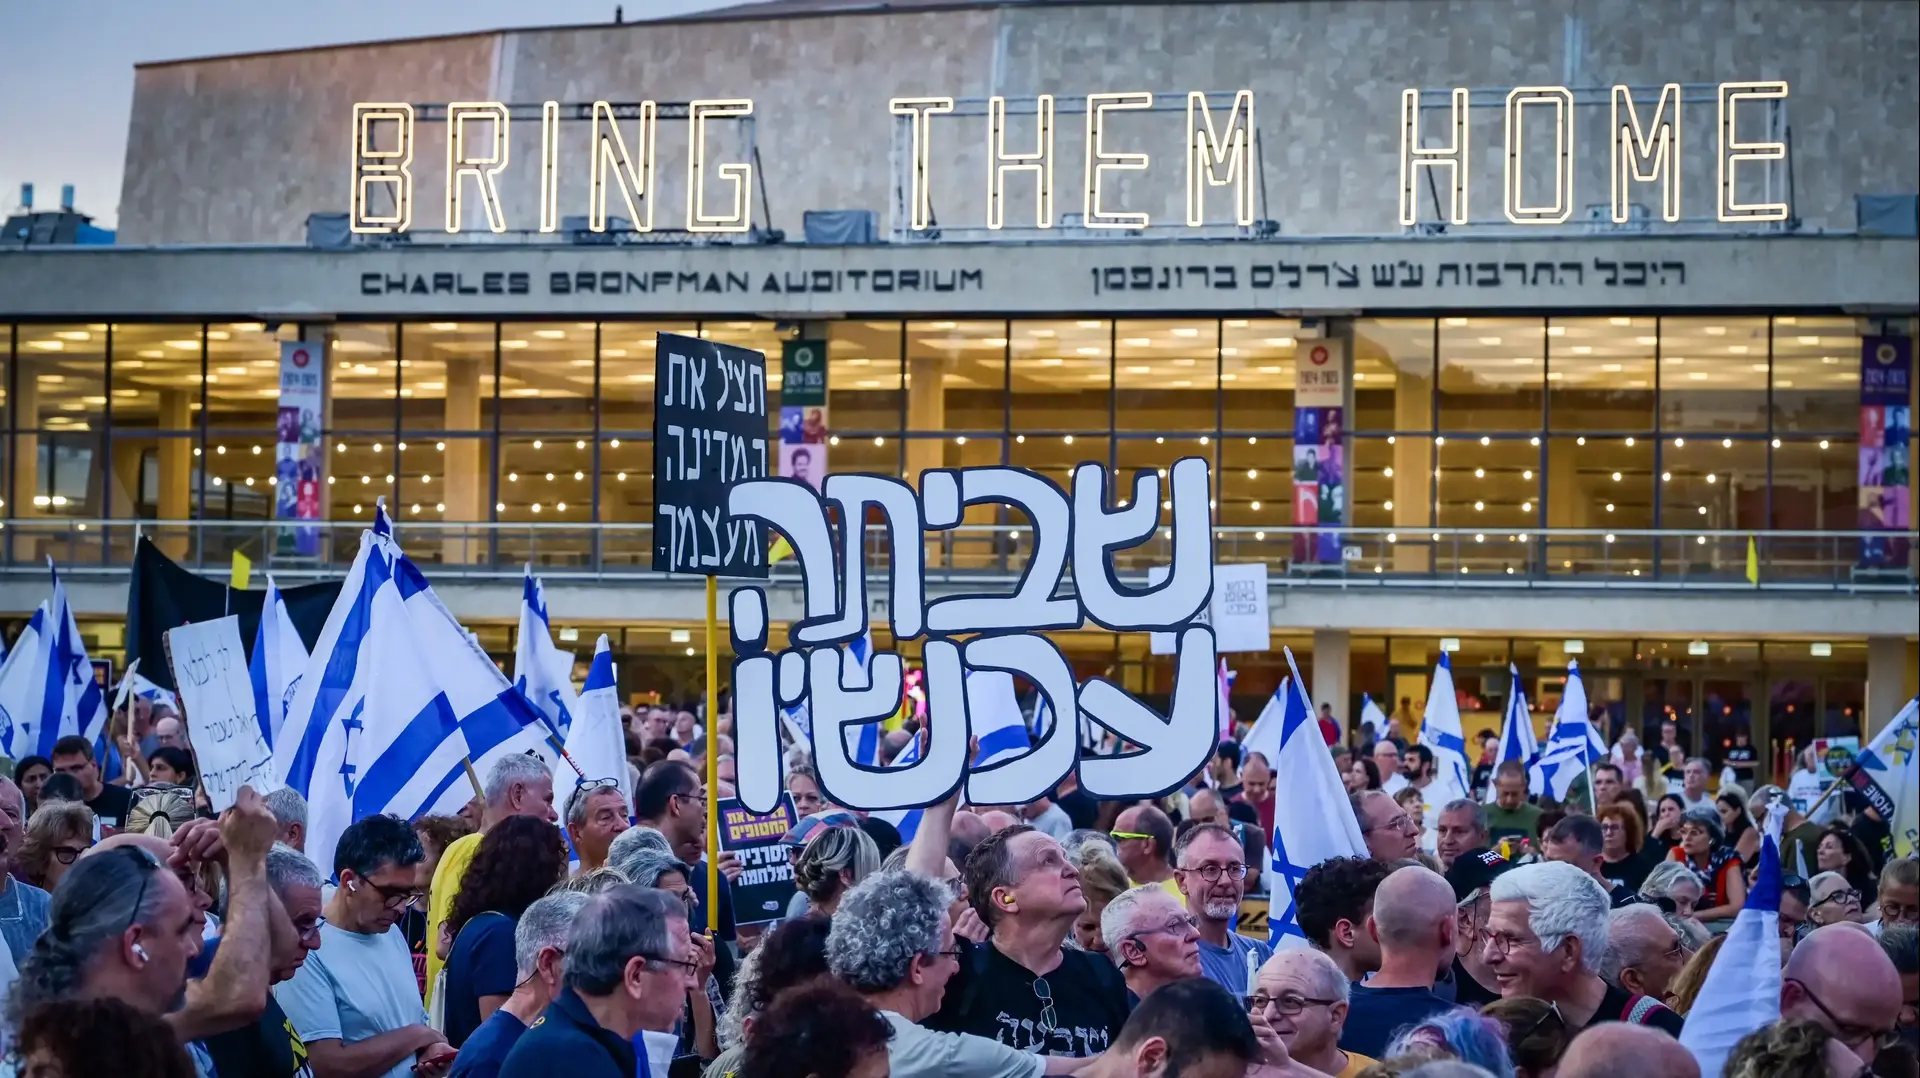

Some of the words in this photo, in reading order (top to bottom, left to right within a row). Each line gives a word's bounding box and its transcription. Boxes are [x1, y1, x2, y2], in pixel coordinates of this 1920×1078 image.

[350, 98, 753, 234] BRING
[888, 89, 1255, 231] THEM
[1398, 80, 1790, 227] HOME
[360, 271, 530, 295] CHARLES
[550, 270, 749, 295] BRONFMAN
[761, 269, 984, 293] AUDITORIUM
[1436, 261, 1584, 287] התרבות
[1594, 257, 1686, 287] היכל
[664, 352, 706, 412] את
[716, 350, 765, 417] תציל
[665, 425, 766, 484] המדינה
[659, 504, 760, 572] מעצמך
[727, 456, 1214, 656] שביתה
[730, 624, 1218, 816] עכשיו
[726, 811, 745, 825] את
[1863, 784, 1893, 816] HOME
[729, 819, 789, 841] החטופים
